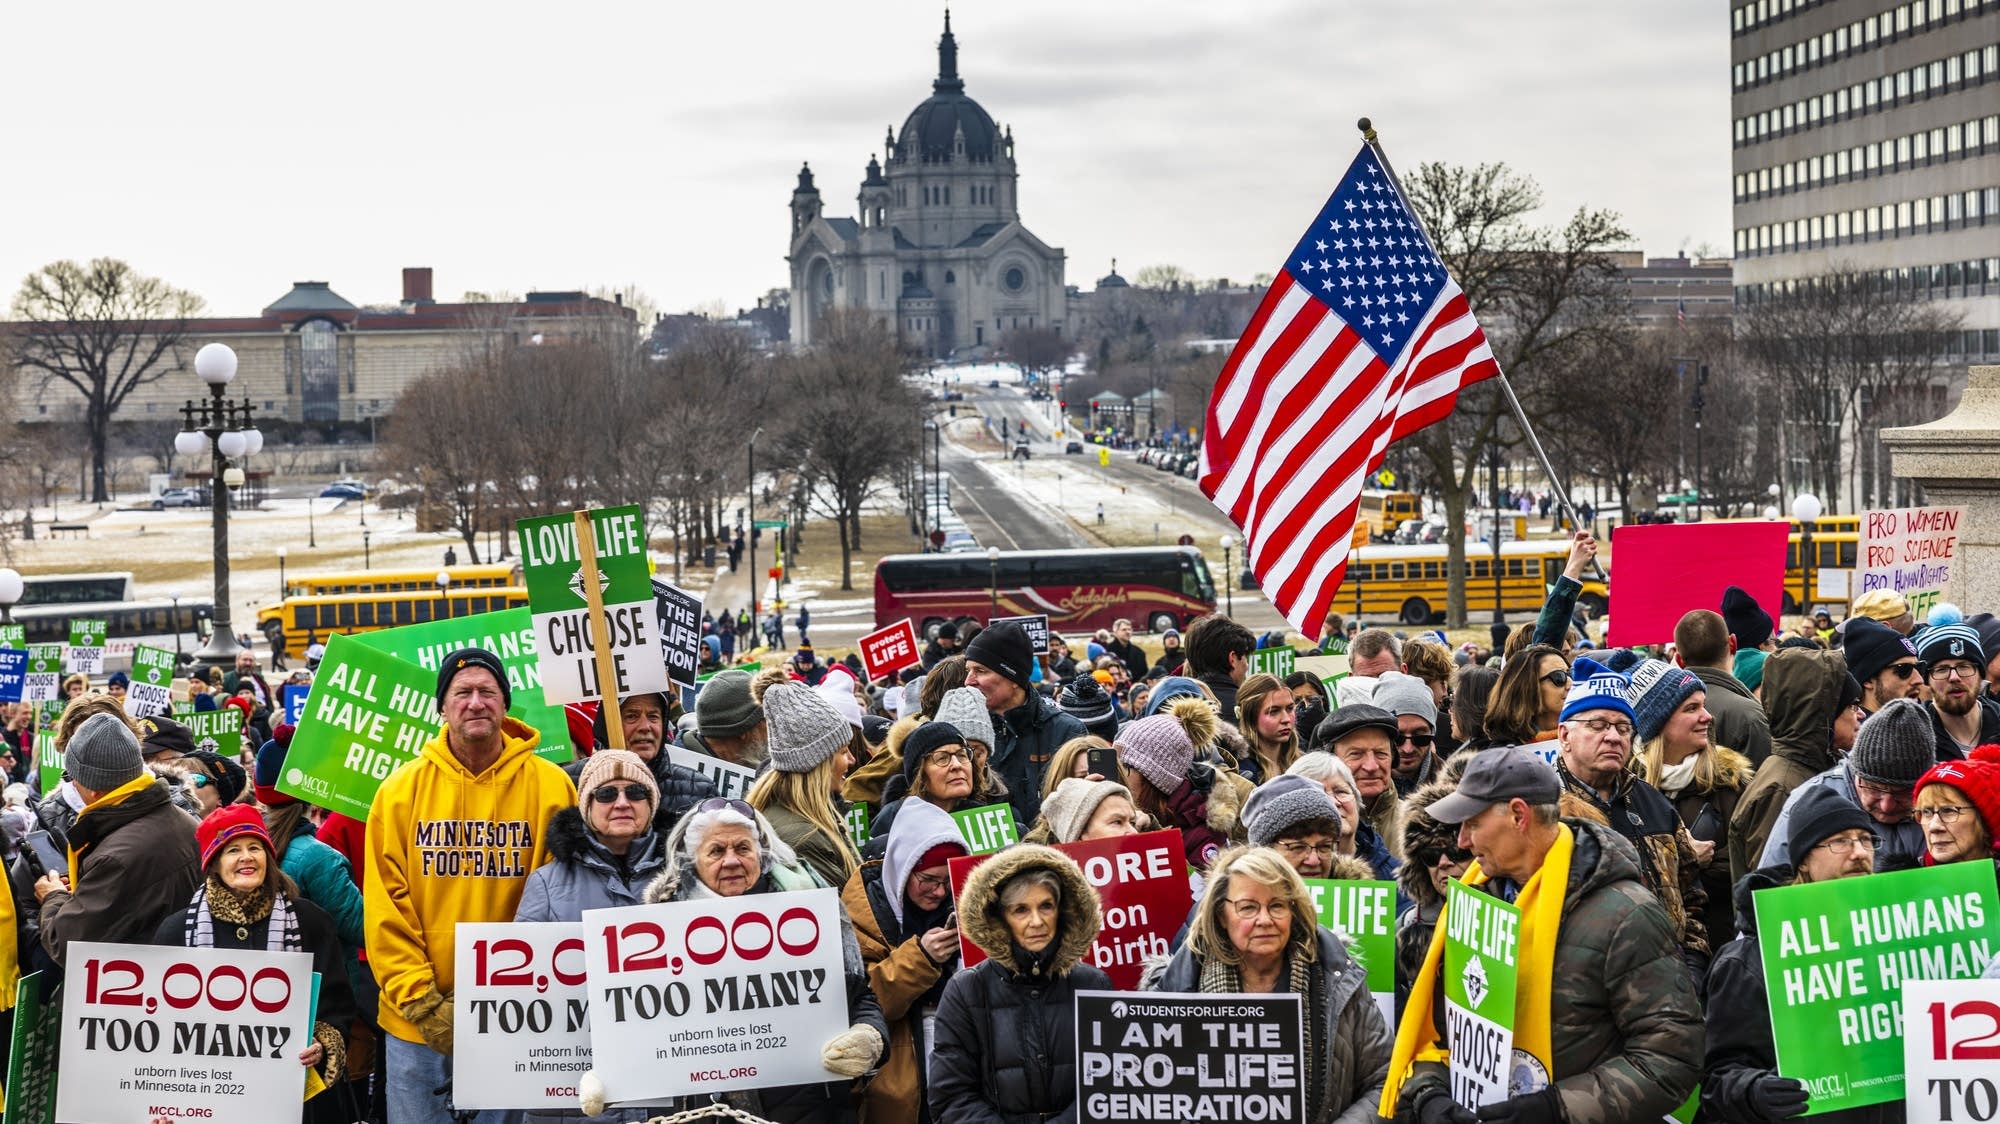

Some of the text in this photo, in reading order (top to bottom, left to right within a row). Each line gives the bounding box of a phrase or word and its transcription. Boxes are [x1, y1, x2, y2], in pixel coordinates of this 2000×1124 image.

[591, 514, 640, 558] LIFE
[1869, 510, 1958, 539] PRO WOMEN
[1868, 537, 1956, 568] PRO SCIENCE
[1864, 573, 1888, 593] PRO
[1060, 586, 1126, 610] Ludolph
[1904, 590, 1941, 621] IFE
[71, 620, 107, 634] LOVE LIFE
[665, 601, 695, 628] THE
[1022, 622, 1042, 630] THE
[7, 626, 24, 641] LIFE
[548, 607, 647, 656] CHOOSE
[869, 630, 905, 653] protect
[44, 646, 60, 660] LIFE
[71, 647, 100, 660] CHOOSE
[76, 660, 92, 673] LIFE
[137, 647, 176, 671] LOVE LIFE
[662, 645, 694, 671] TION
[872, 640, 910, 667] LIFE
[1266, 650, 1292, 681] LIFE
[25, 674, 54, 687] CHOOSE
[327, 662, 378, 703] ALL
[577, 654, 630, 697] LIE
[30, 687, 46, 700] LIFE
[132, 683, 166, 705] CHOOSE
[135, 703, 157, 719] LIFE
[212, 711, 239, 735] LIFE
[316, 694, 390, 743] HAVE
[41, 734, 66, 768] LOV
[301, 774, 329, 795] MCCL
[415, 820, 533, 849] MINNESOTA
[845, 808, 866, 847] FE
[963, 809, 1014, 852] LIFE
[422, 850, 525, 878] FOOTBALL
[1083, 847, 1173, 887] ORE
[1333, 886, 1388, 935] LIFE
[1448, 885, 1518, 967] LOVE LIFE
[1780, 892, 1986, 958] ALL HUMANS
[602, 907, 820, 976] 12,000
[1092, 932, 1169, 969] birth
[472, 938, 587, 993] 12,0
[1783, 938, 1993, 1007] HAVE HUMAN
[84, 959, 291, 1014] 12,000
[605, 981, 691, 1023] TOO
[704, 967, 826, 1014] MANY
[470, 999, 553, 1034] TOO
[1129, 1005, 1265, 1017] STUDENTSFORLIFE.ORG
[34, 1003, 48, 1057] AVE
[79, 1016, 291, 1059] TOO MANY
[669, 1022, 773, 1043] unborn lives lost
[1092, 1021, 1282, 1048] I AM THE
[1927, 1001, 2000, 1060] 12
[529, 1046, 572, 1057] unborn
[656, 1036, 787, 1060] in Minnesota in 2022
[1447, 1007, 1504, 1085] CHOOSE
[134, 1066, 232, 1080] unborn lives lost
[515, 1060, 592, 1072] in Minnesota
[690, 1066, 758, 1082] MCCL.ORG
[1083, 1051, 1296, 1089] PRO-LIFE
[38, 1044, 55, 1124] HUMA
[120, 1079, 245, 1095] in Minnesota in 2022
[546, 1087, 579, 1097] MCCL
[1809, 1075, 1845, 1096] MCCL
[149, 1106, 213, 1118] MCCL.ORG
[1087, 1093, 1293, 1122] GENERATION
[1928, 1078, 1998, 1122] TO
